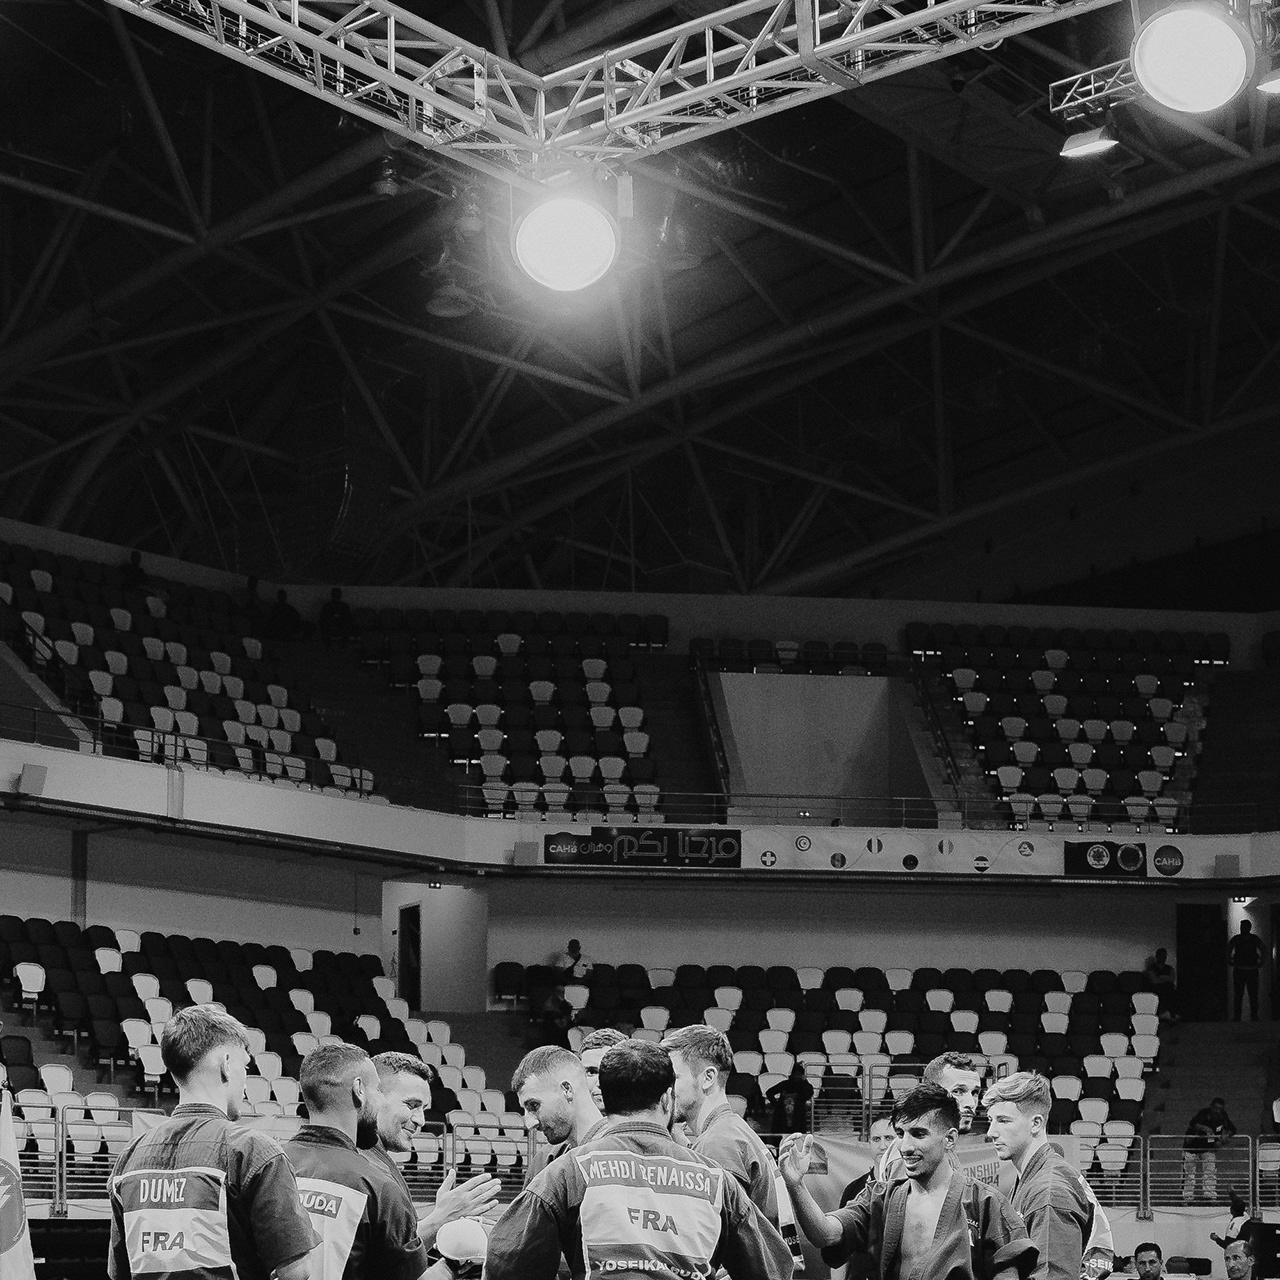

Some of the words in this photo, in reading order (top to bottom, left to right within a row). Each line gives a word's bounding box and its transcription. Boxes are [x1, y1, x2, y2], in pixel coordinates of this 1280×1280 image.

[613, 831, 668, 863] بكم
[678, 831, 739, 863] مرحبا
[140, 1177, 186, 1203] DUMEZ
[589, 1160, 636, 1180] MEHDI
[640, 1164, 711, 1196] BENAISSA
[978, 1174, 1000, 1187] 024
[627, 1206, 679, 1236] FRA
[141, 1231, 185, 1252] FRA
[595, 1259, 668, 1271] YOSEIKA
[670, 1266, 706, 1280] BUD
